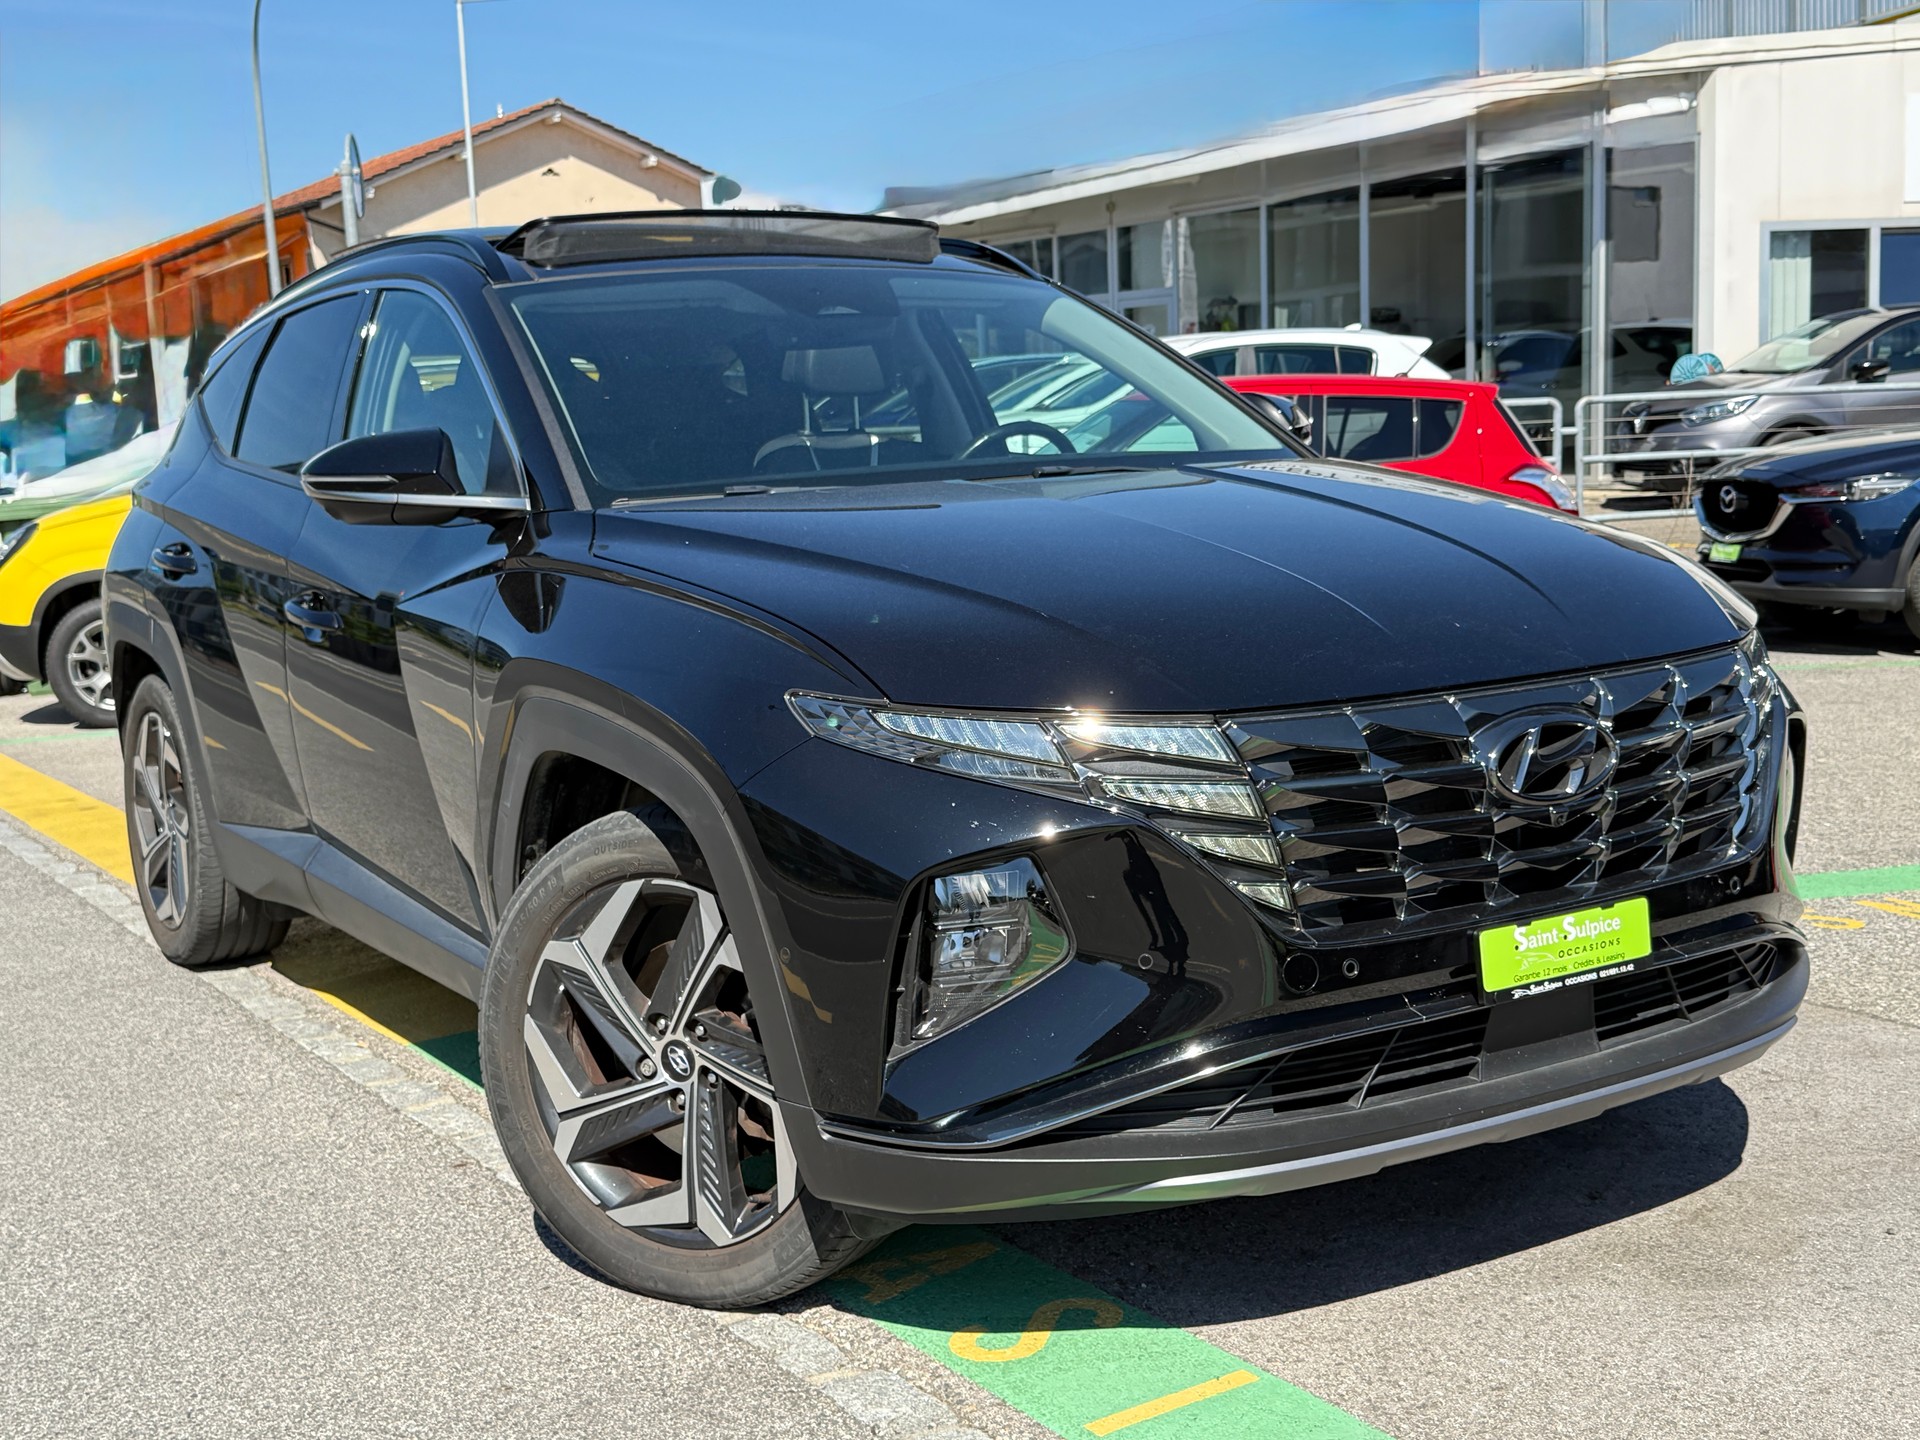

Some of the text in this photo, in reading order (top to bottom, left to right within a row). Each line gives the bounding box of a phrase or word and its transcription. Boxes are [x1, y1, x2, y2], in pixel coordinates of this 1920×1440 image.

[594, 840, 632, 856] OUTSIDE
[1558, 938, 1621, 958] OCCASIONS
[1543, 967, 1551, 977] 12
[1552, 965, 1567, 975] mois
[1603, 952, 1625, 963] Leasing
